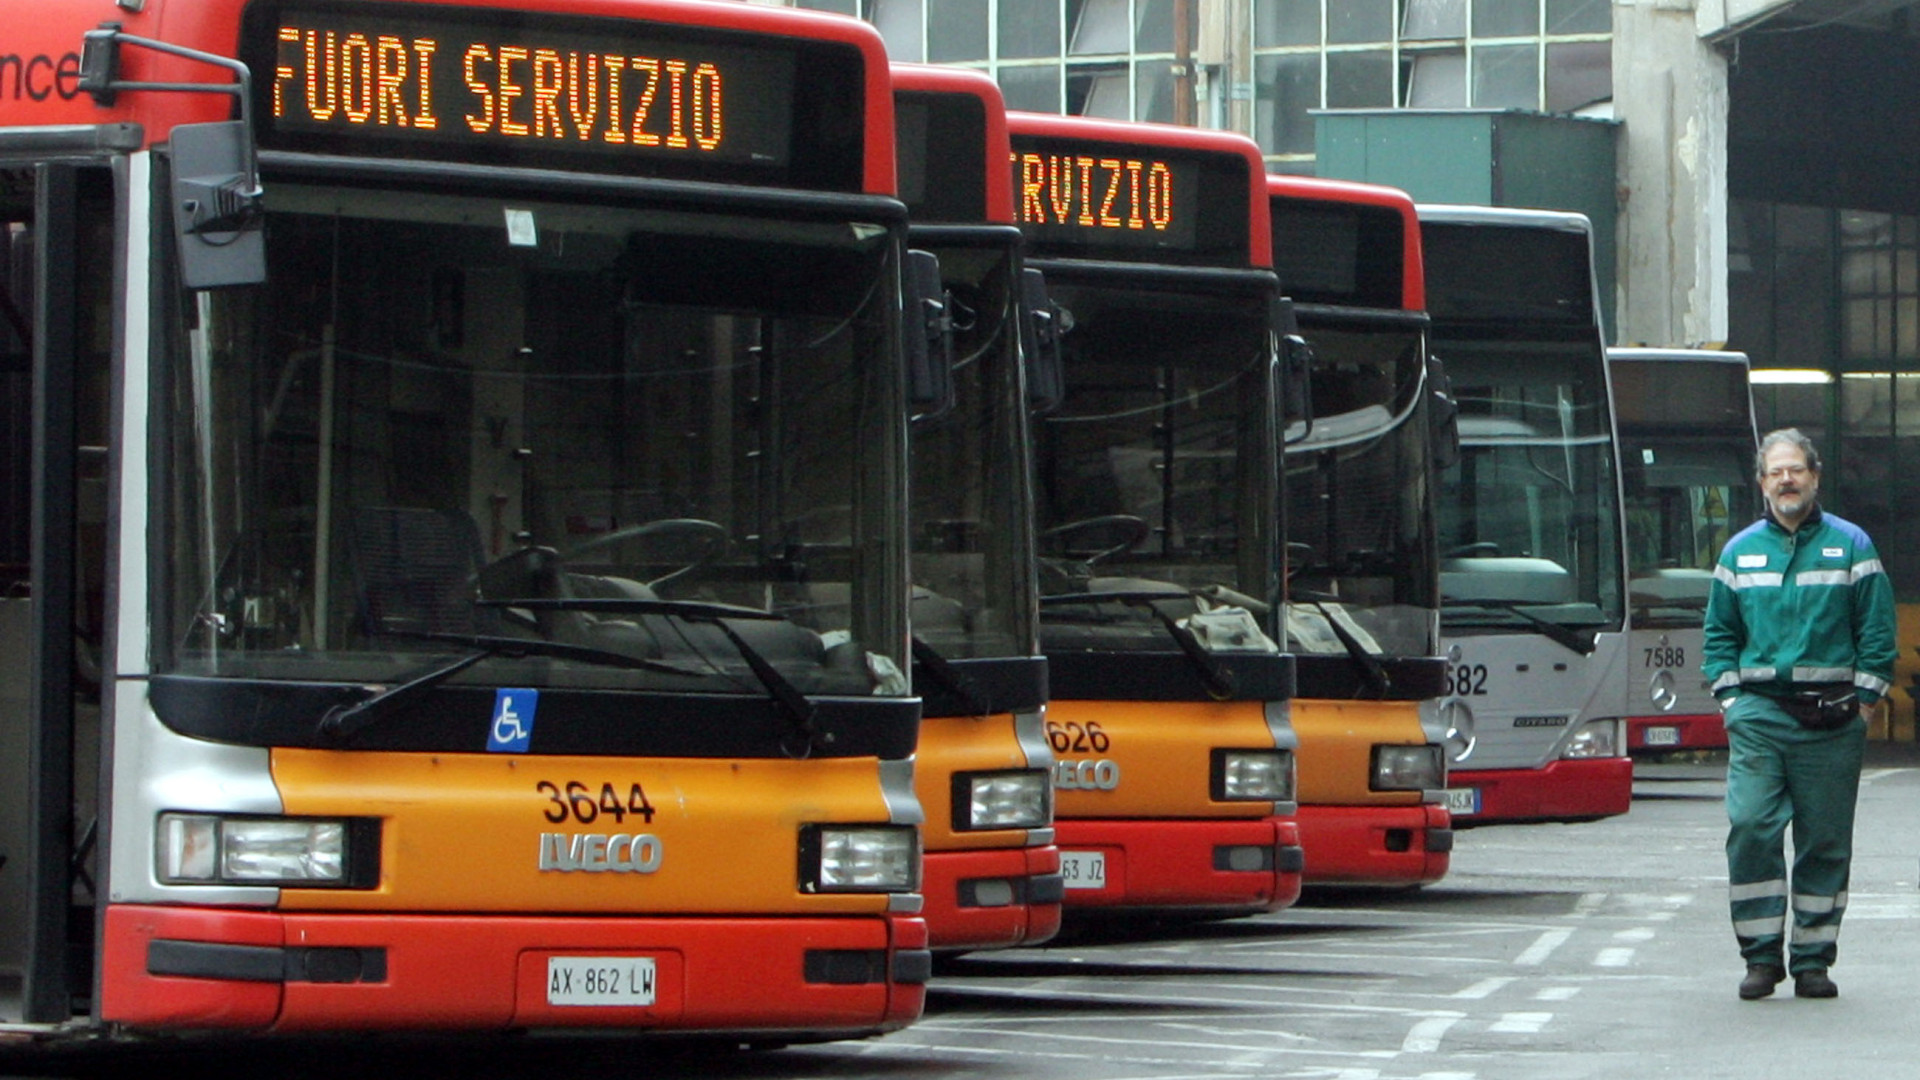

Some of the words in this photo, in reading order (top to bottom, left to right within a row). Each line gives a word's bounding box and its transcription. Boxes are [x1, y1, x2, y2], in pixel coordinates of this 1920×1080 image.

[0, 52, 81, 101] nce
[272, 26, 438, 131] FUORI
[463, 43, 724, 150] SERVIZIO
[1010, 151, 1174, 231] RVIZIO
[1643, 647, 1685, 668] 7588
[1045, 721, 1110, 753] 626
[536, 780, 655, 824] 3644
[538, 832, 664, 873] IVECO
[1062, 859, 1080, 880] 63
[1086, 859, 1103, 880] JZ
[585, 968, 621, 994] 862
